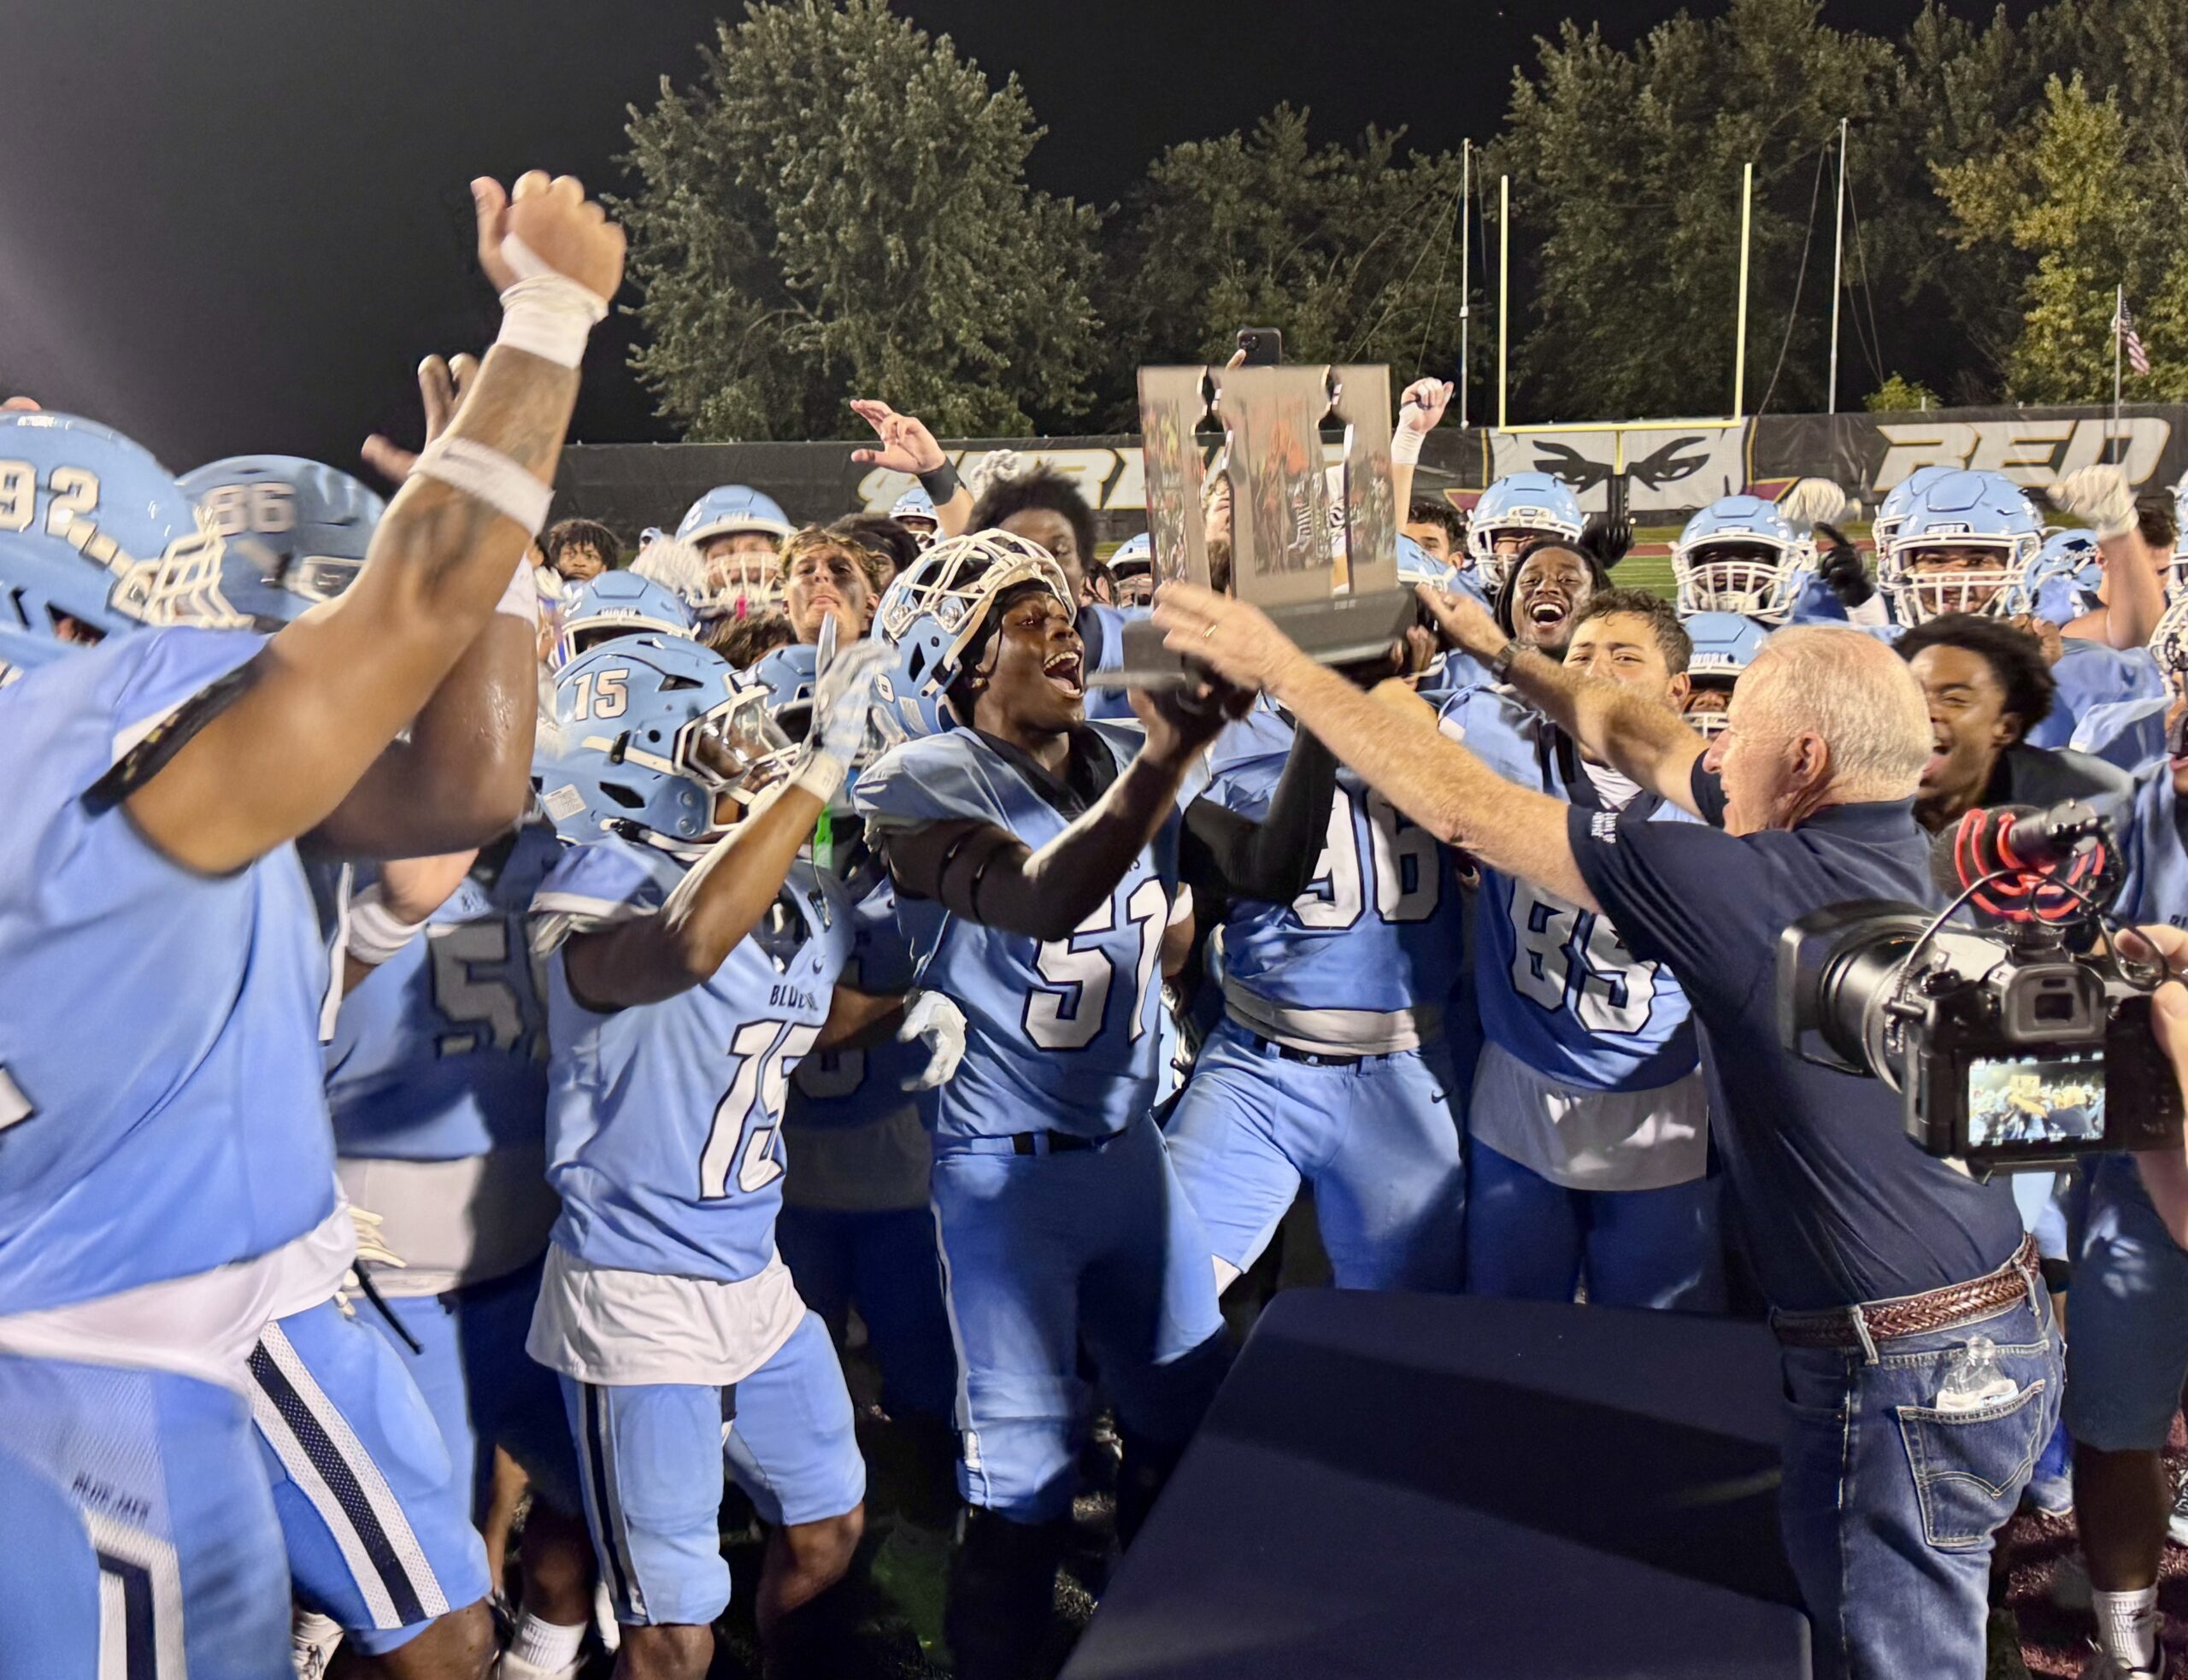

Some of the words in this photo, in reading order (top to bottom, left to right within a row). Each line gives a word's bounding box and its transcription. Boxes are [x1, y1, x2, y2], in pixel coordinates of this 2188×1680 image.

[1873, 417, 2171, 492] RED
[0, 459, 100, 537] 92
[202, 481, 297, 537] 86
[574, 668, 630, 721] 15
[1020, 874, 1169, 1054] 51
[697, 1018, 823, 1201] 15
